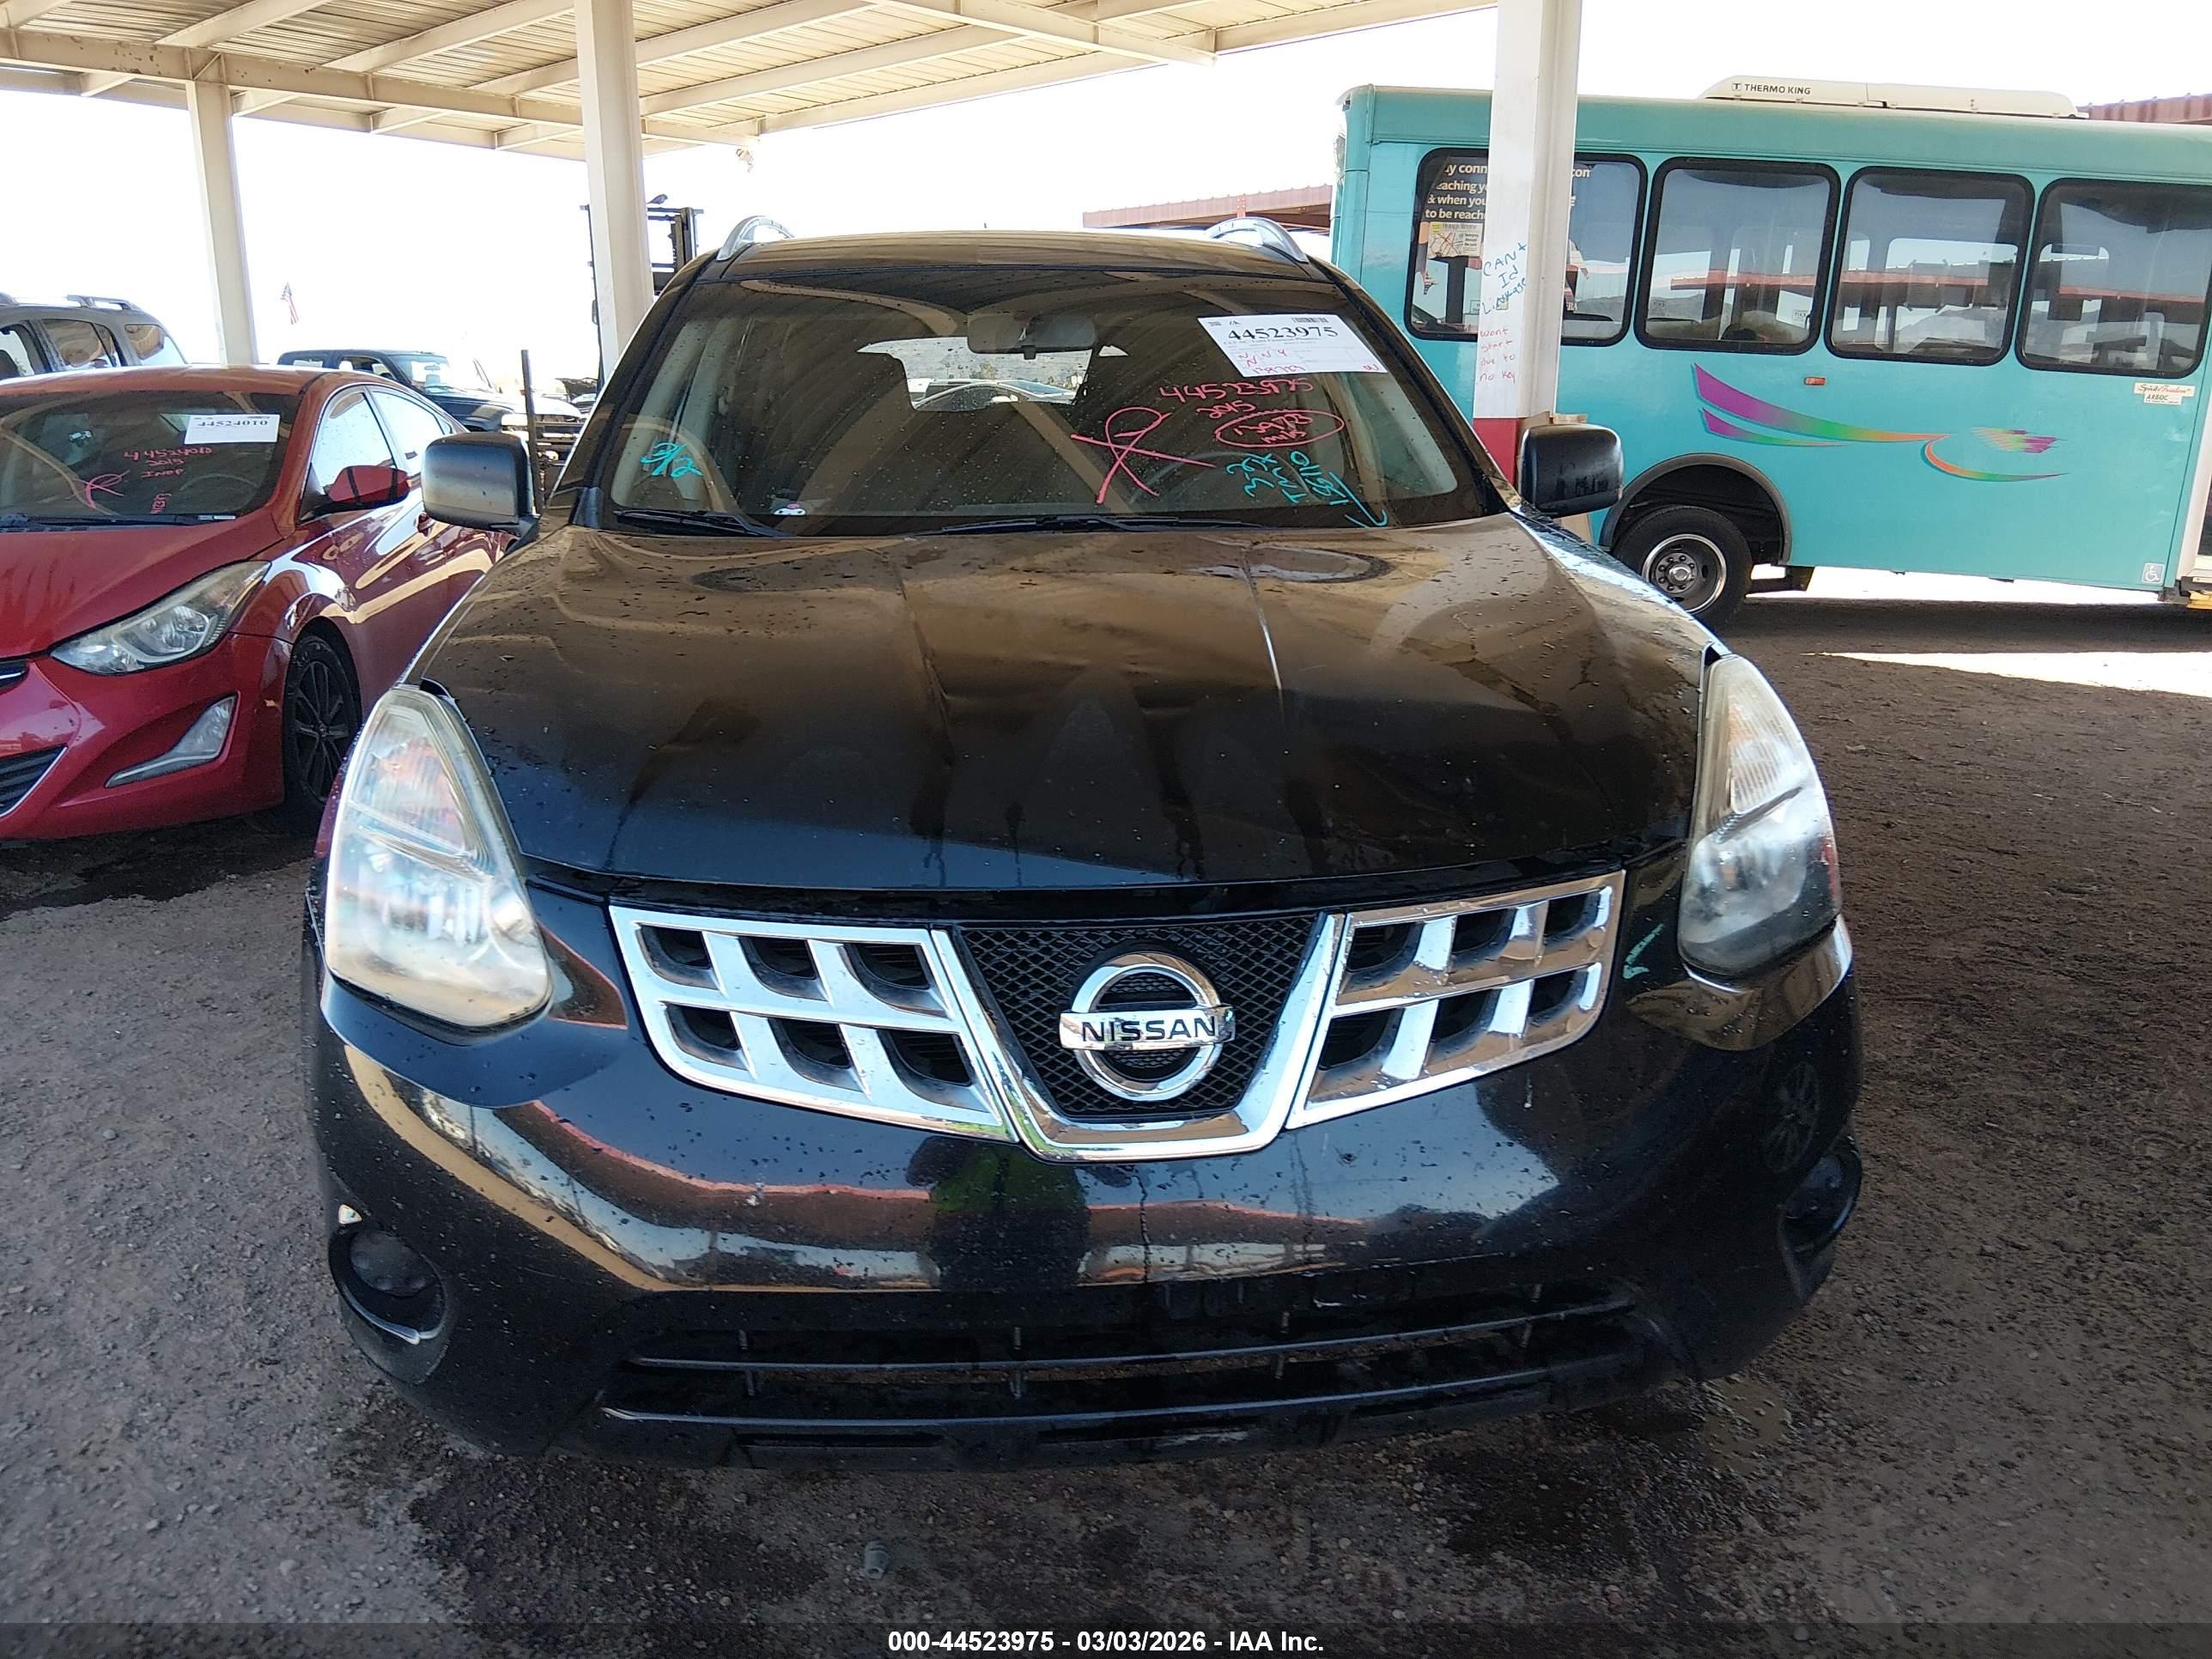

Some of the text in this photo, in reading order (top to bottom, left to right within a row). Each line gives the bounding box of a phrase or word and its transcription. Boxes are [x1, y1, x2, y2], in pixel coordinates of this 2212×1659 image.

[1745, 83, 1786, 94] THERMO
[1787, 86, 1812, 95] KING
[1427, 194, 1437, 204] &
[1437, 193, 1468, 205] when
[1425, 208, 1486, 220] to be reach
[1228, 325, 1339, 340] 44523975
[1158, 377, 1314, 404] 44523975
[197, 419, 269, 428] 44524010
[1080, 1015, 1217, 1043] NISSAN
